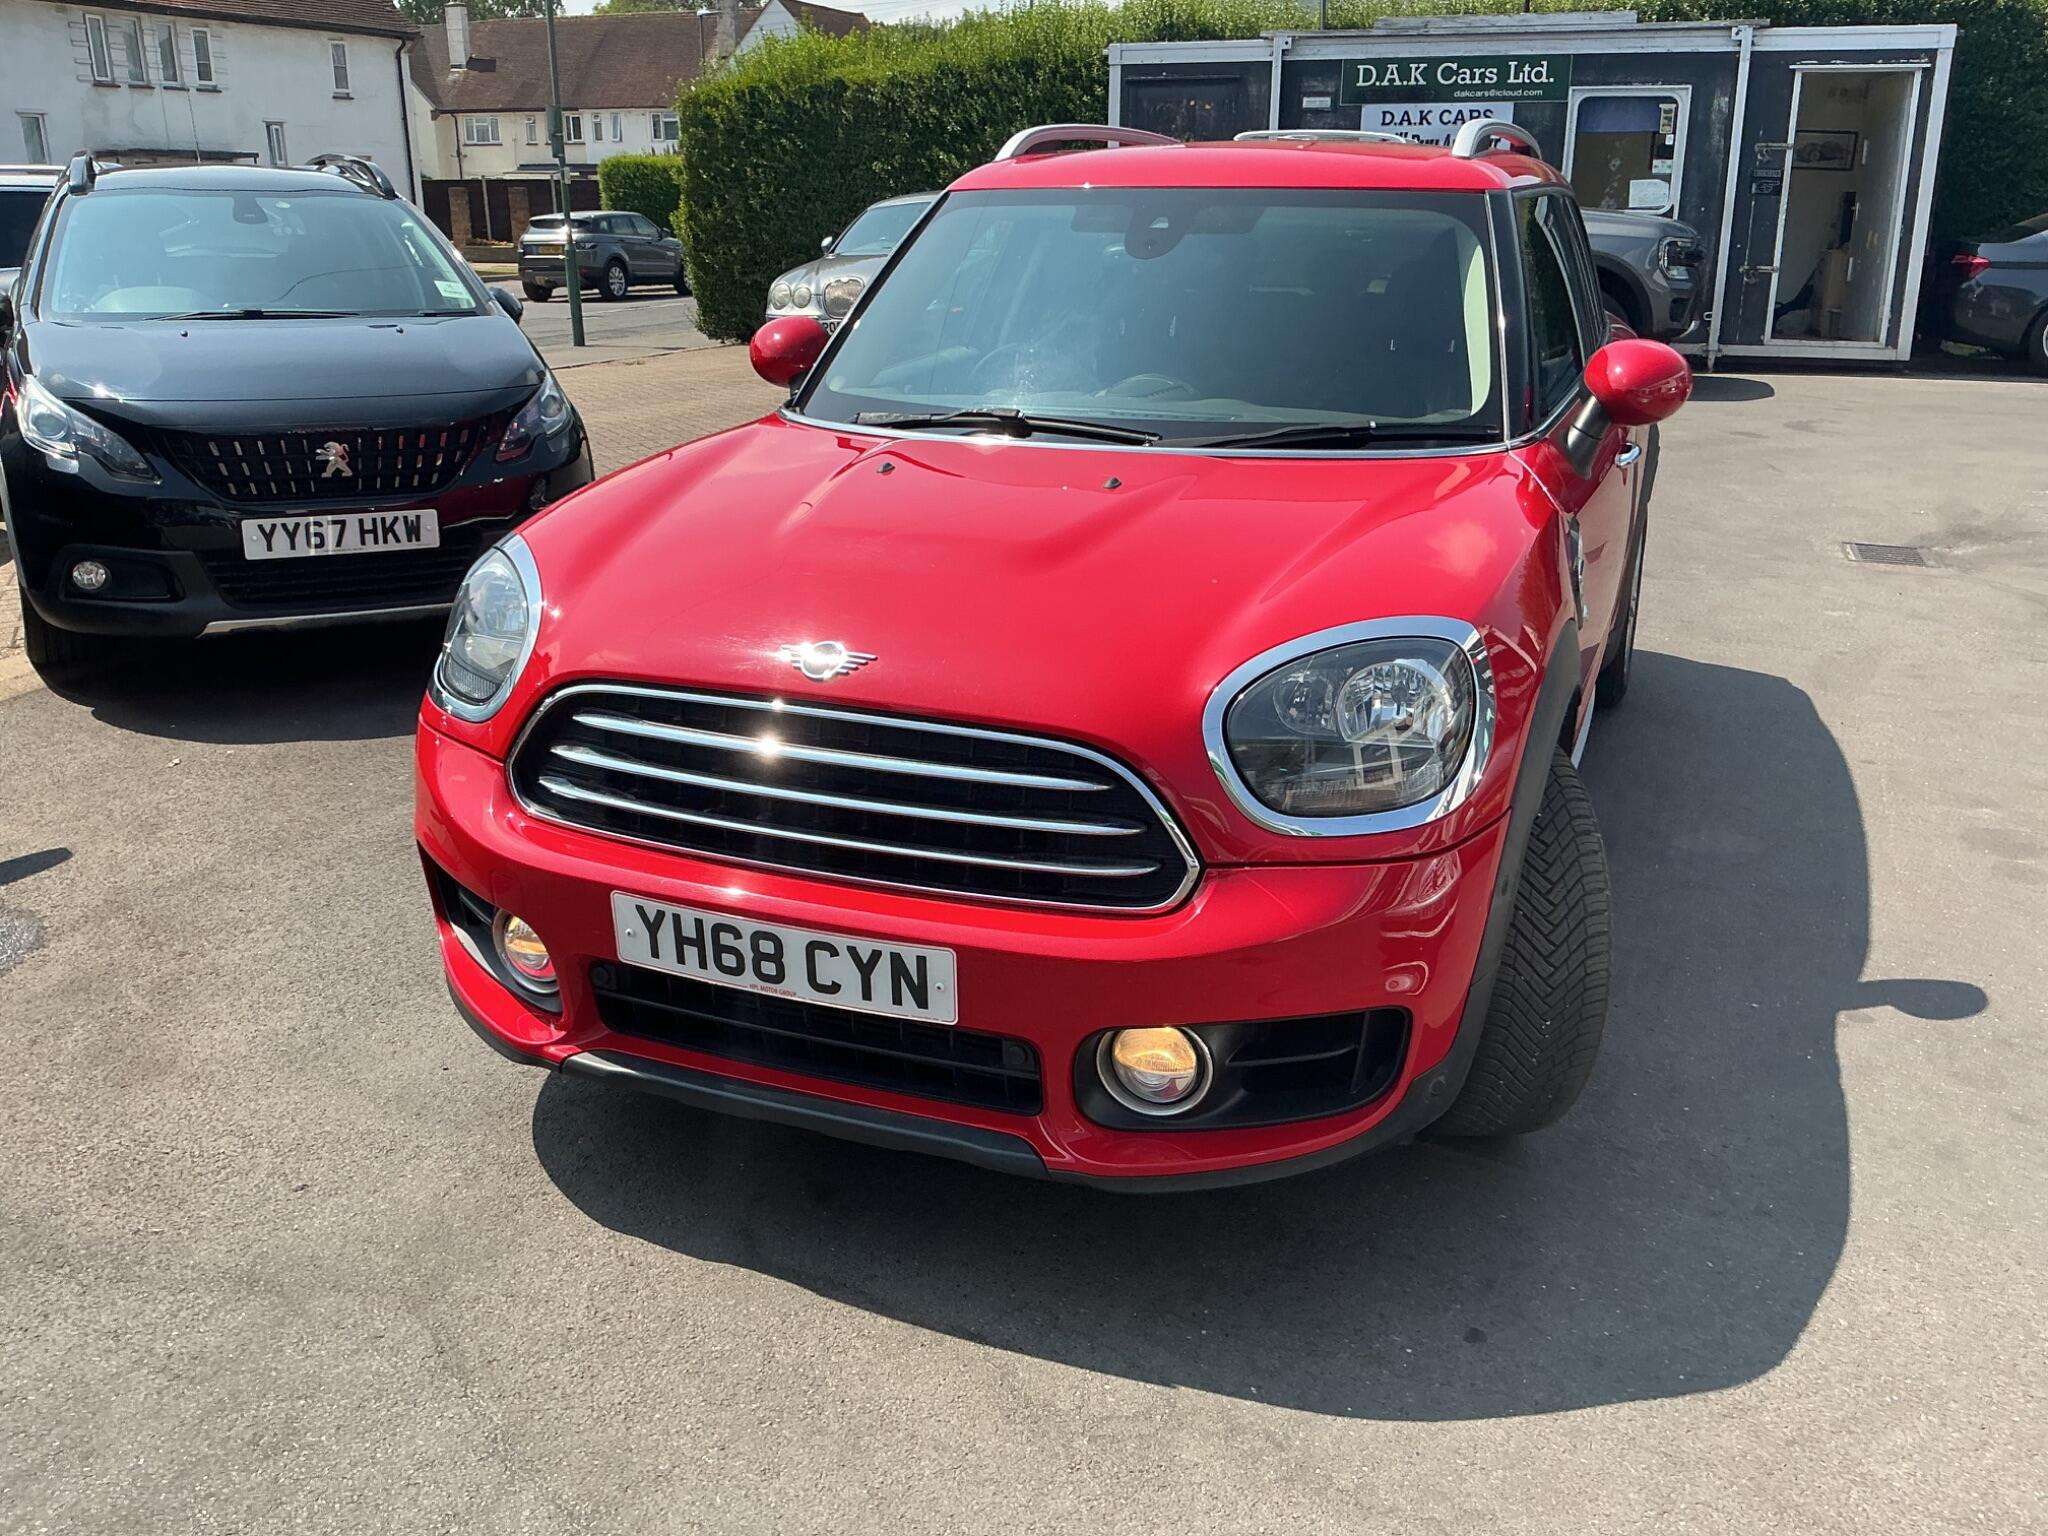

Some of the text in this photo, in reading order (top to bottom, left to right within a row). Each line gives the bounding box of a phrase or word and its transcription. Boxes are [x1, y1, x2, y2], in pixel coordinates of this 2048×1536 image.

[1356, 61, 1555, 87] D.A.K Cars Ltd.
[1453, 88, 1543, 98] dakcars@icloud.com
[1381, 110, 1432, 126] D.A.K
[257, 514, 421, 552] YY67 HKW
[635, 904, 929, 1010] YH68 CYN
